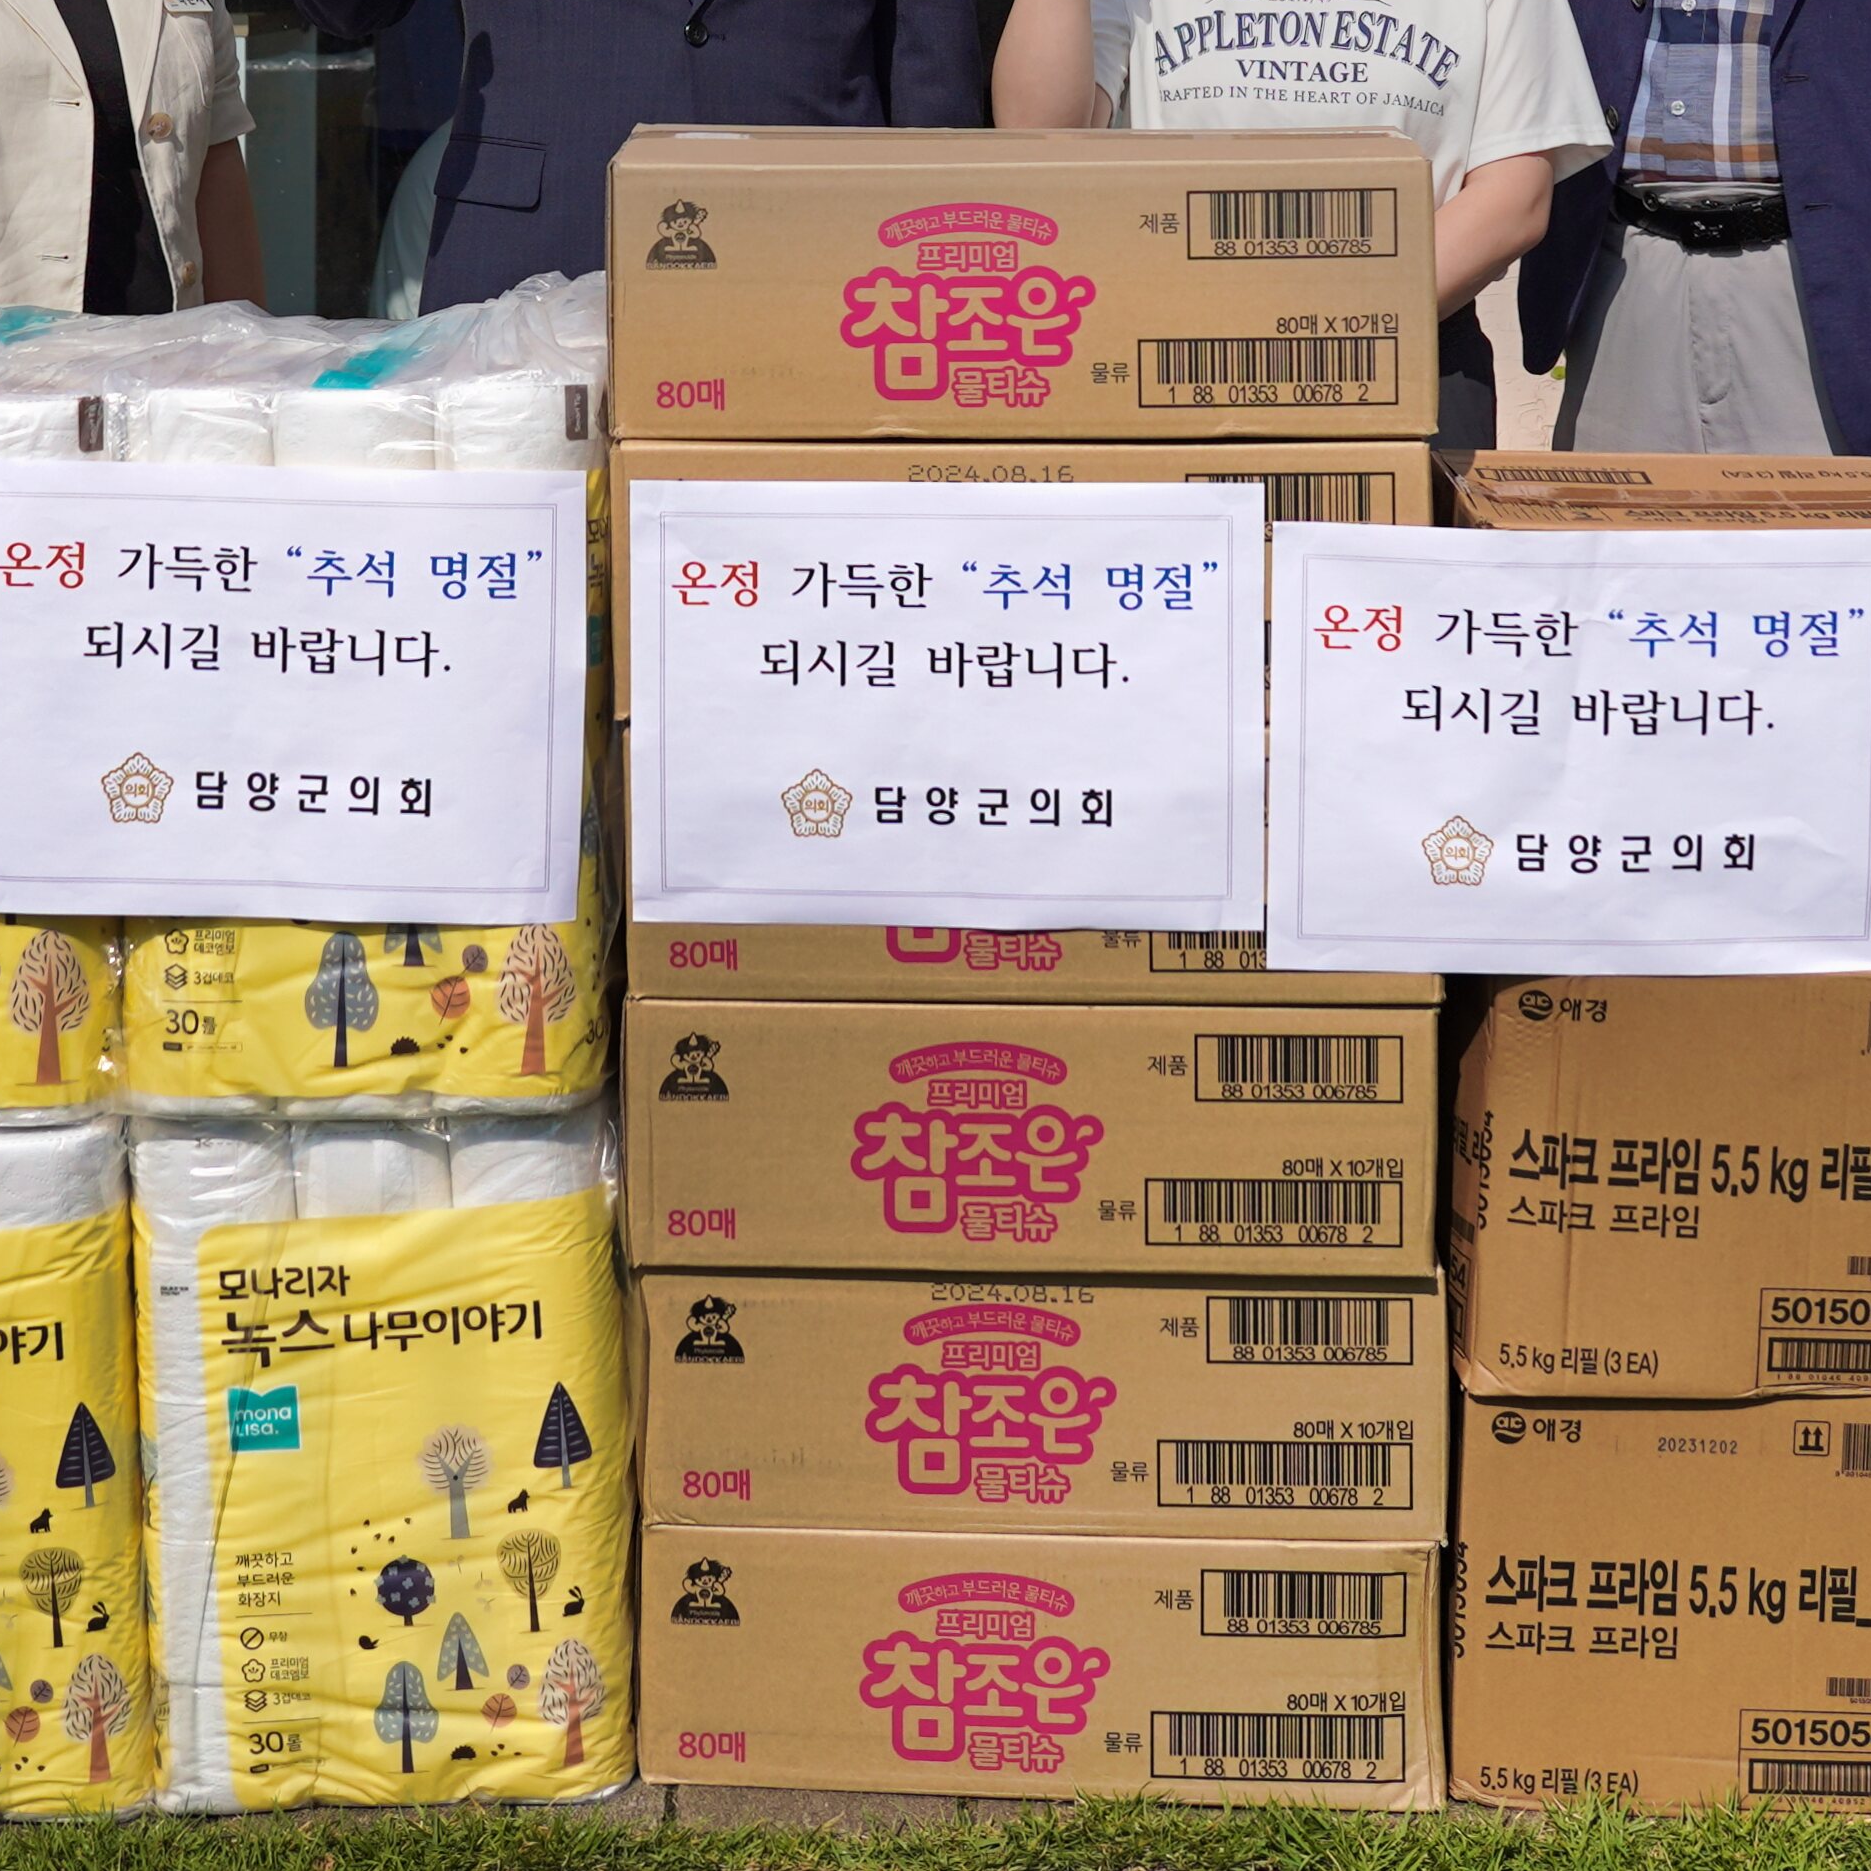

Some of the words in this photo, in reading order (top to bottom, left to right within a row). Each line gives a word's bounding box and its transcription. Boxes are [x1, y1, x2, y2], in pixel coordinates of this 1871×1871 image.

[1155, 10, 1328, 81] APPLETON
[1329, 11, 1459, 90] ESTATE
[1236, 59, 1368, 83] VINTAGE
[1230, 86, 1247, 98] IN
[1253, 87, 1287, 101] THE
[1294, 90, 1351, 104] HEART
[1356, 92, 1378, 105] OF
[1383, 92, 1444, 116] JAMAICA
[885, 216, 941, 241] 깨끗하고
[943, 210, 1004, 230] 부드러운
[1007, 214, 1052, 241] 물티슈
[1139, 213, 1180, 234] 제품
[917, 242, 1018, 272] 프리미엄
[1213, 236, 1239, 256] 88
[1241, 236, 1302, 256] 01353
[1304, 236, 1374, 258] 006785
[846, 271, 1092, 396] 참조은
[1276, 314, 1318, 335] 80매
[1342, 313, 1398, 334] 10개입
[949, 366, 1050, 409] 물티슈
[1091, 362, 1130, 384] 물류
[656, 378, 725, 411] 80매
[118, 543, 258, 592] 가득한
[287, 546, 394, 598] “추석
[430, 550, 542, 600] 명절”
[672, 560, 758, 607] 온정
[792, 561, 933, 609] 가득한
[962, 561, 1070, 610] “추석
[1106, 561, 1218, 611] 명절”
[1314, 605, 1402, 652] 온정
[1436, 609, 1579, 657] 가득한
[1608, 610, 1717, 658] “추석
[1753, 608, 1864, 658] 명절”
[83, 621, 220, 671] 되시길
[251, 626, 450, 678] 바랍니다.
[760, 639, 896, 687] 되시길
[927, 641, 1129, 689] 바랍니다.
[1403, 685, 1540, 735] 되시길
[1572, 689, 1774, 736] 바랍니다.
[196, 771, 431, 817] 담양군의회
[875, 786, 1112, 827] 담양군의회
[1517, 834, 1755, 874] 담양군의회
[1555, 997, 1607, 1023] 애경
[1148, 1055, 1188, 1076] 제품
[1509, 1129, 1598, 1190] 스파크
[1608, 1137, 1701, 1195] 프라임
[1711, 1144, 1760, 1197] 5.5
[1770, 1146, 1808, 1203] kg
[219, 1265, 350, 1300] 모나리자
[928, 1281, 1097, 1306] 2024.08.16
[221, 1309, 335, 1368] 녹스
[344, 1300, 542, 1352] 나무이야기
[1499, 1343, 1527, 1368] 5.5
[1532, 1347, 1555, 1374] kg
[1561, 1347, 1598, 1375] 리필
[1604, 1348, 1621, 1376] (3
[1627, 1350, 1658, 1378] EA)
[1533, 1419, 1581, 1443] 애경
[1658, 1437, 1737, 1455] 20231202
[683, 1469, 750, 1501] 80매
[235, 1551, 293, 1568] 깨끗하고
[236, 1572, 296, 1587] 부드러운
[1486, 1555, 1577, 1612] 스파크
[1587, 1559, 1678, 1616] 프라임
[1689, 1565, 1737, 1618] 5.5
[1748, 1567, 1786, 1624] kg
[239, 1592, 281, 1608] 화장지
[865, 1635, 1105, 1757] 참조은
